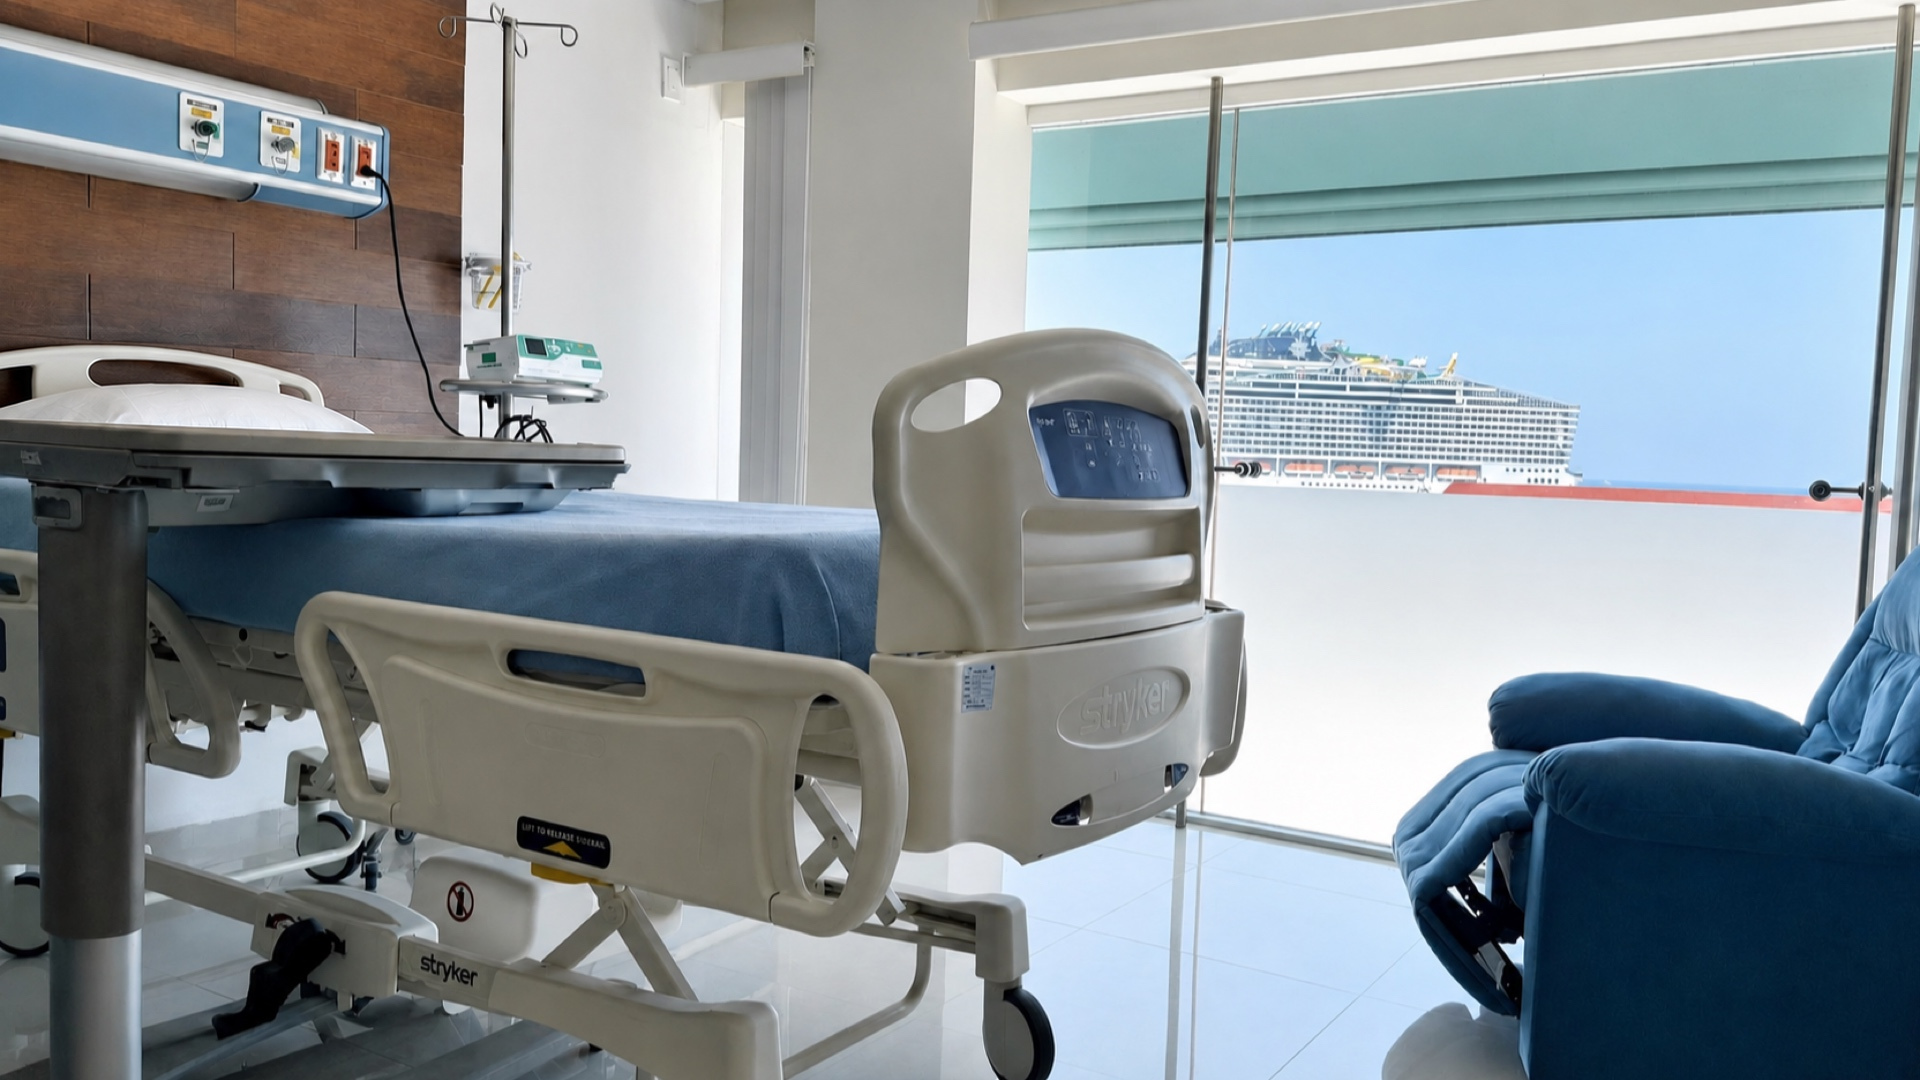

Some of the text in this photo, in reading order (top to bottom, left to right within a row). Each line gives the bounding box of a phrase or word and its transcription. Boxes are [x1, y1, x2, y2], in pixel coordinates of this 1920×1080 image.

[1080, 677, 1170, 736] stryker
[522, 823, 605, 849] LIFT TO RELEASE SIDERAIL
[420, 953, 478, 987] stryker
